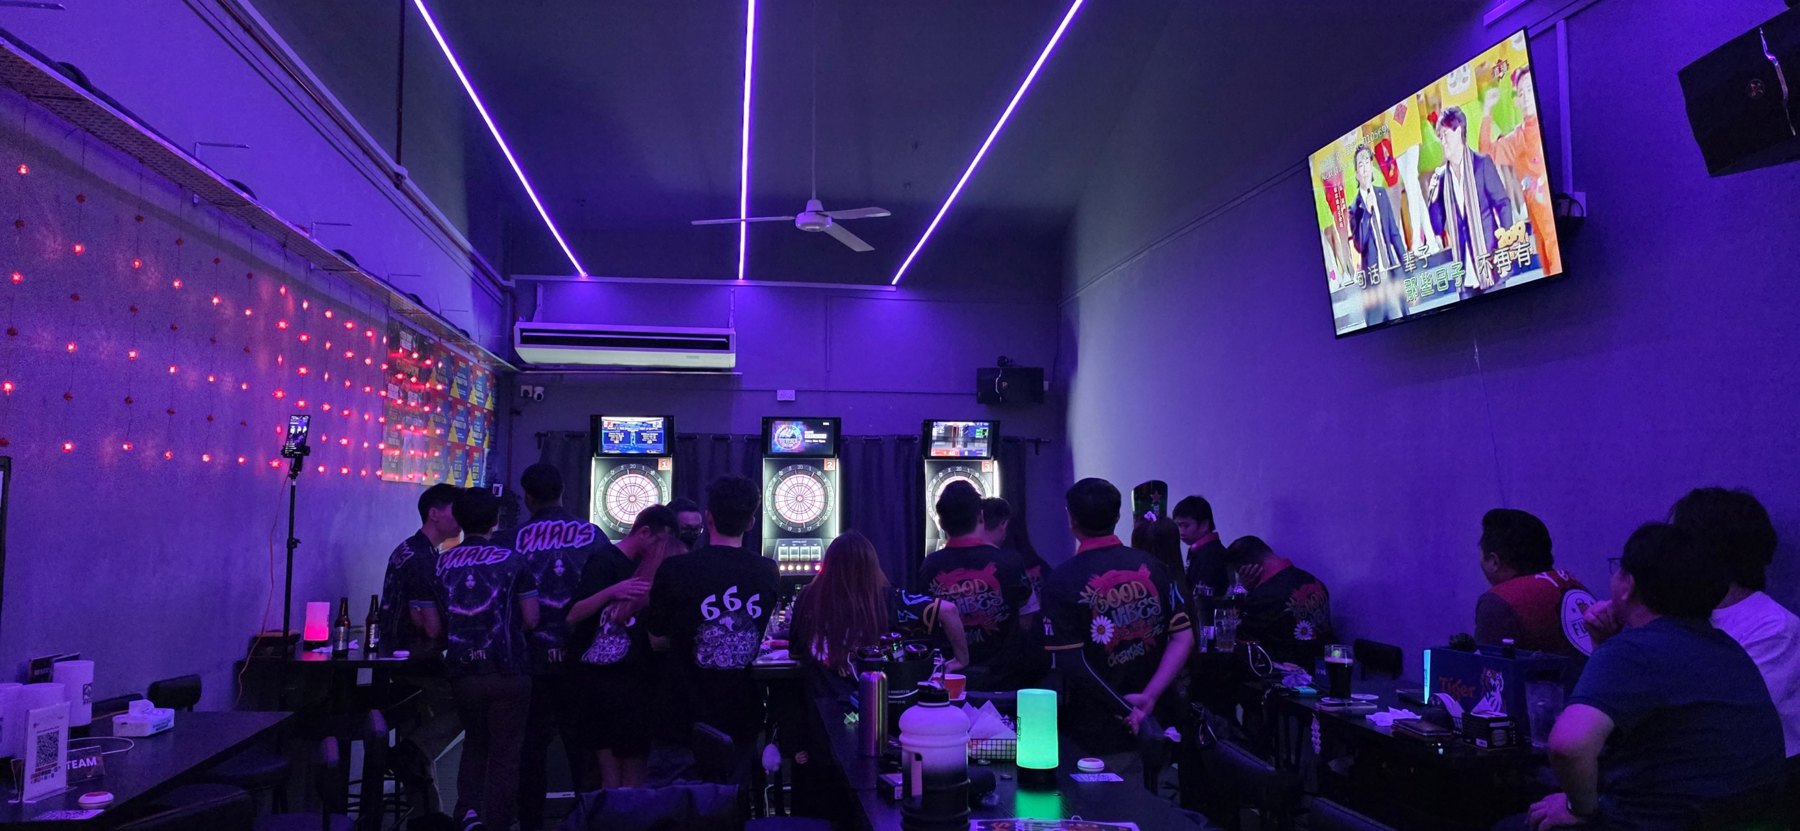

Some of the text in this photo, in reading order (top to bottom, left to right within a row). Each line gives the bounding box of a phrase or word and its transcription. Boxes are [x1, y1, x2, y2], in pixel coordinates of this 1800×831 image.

[516, 520, 595, 553] CHAOS
[436, 546, 511, 576] CHAOS
[1095, 581, 1147, 613] GOOD
[1439, 676, 1476, 701] Tiger
[66, 756, 97, 770] TEAM
